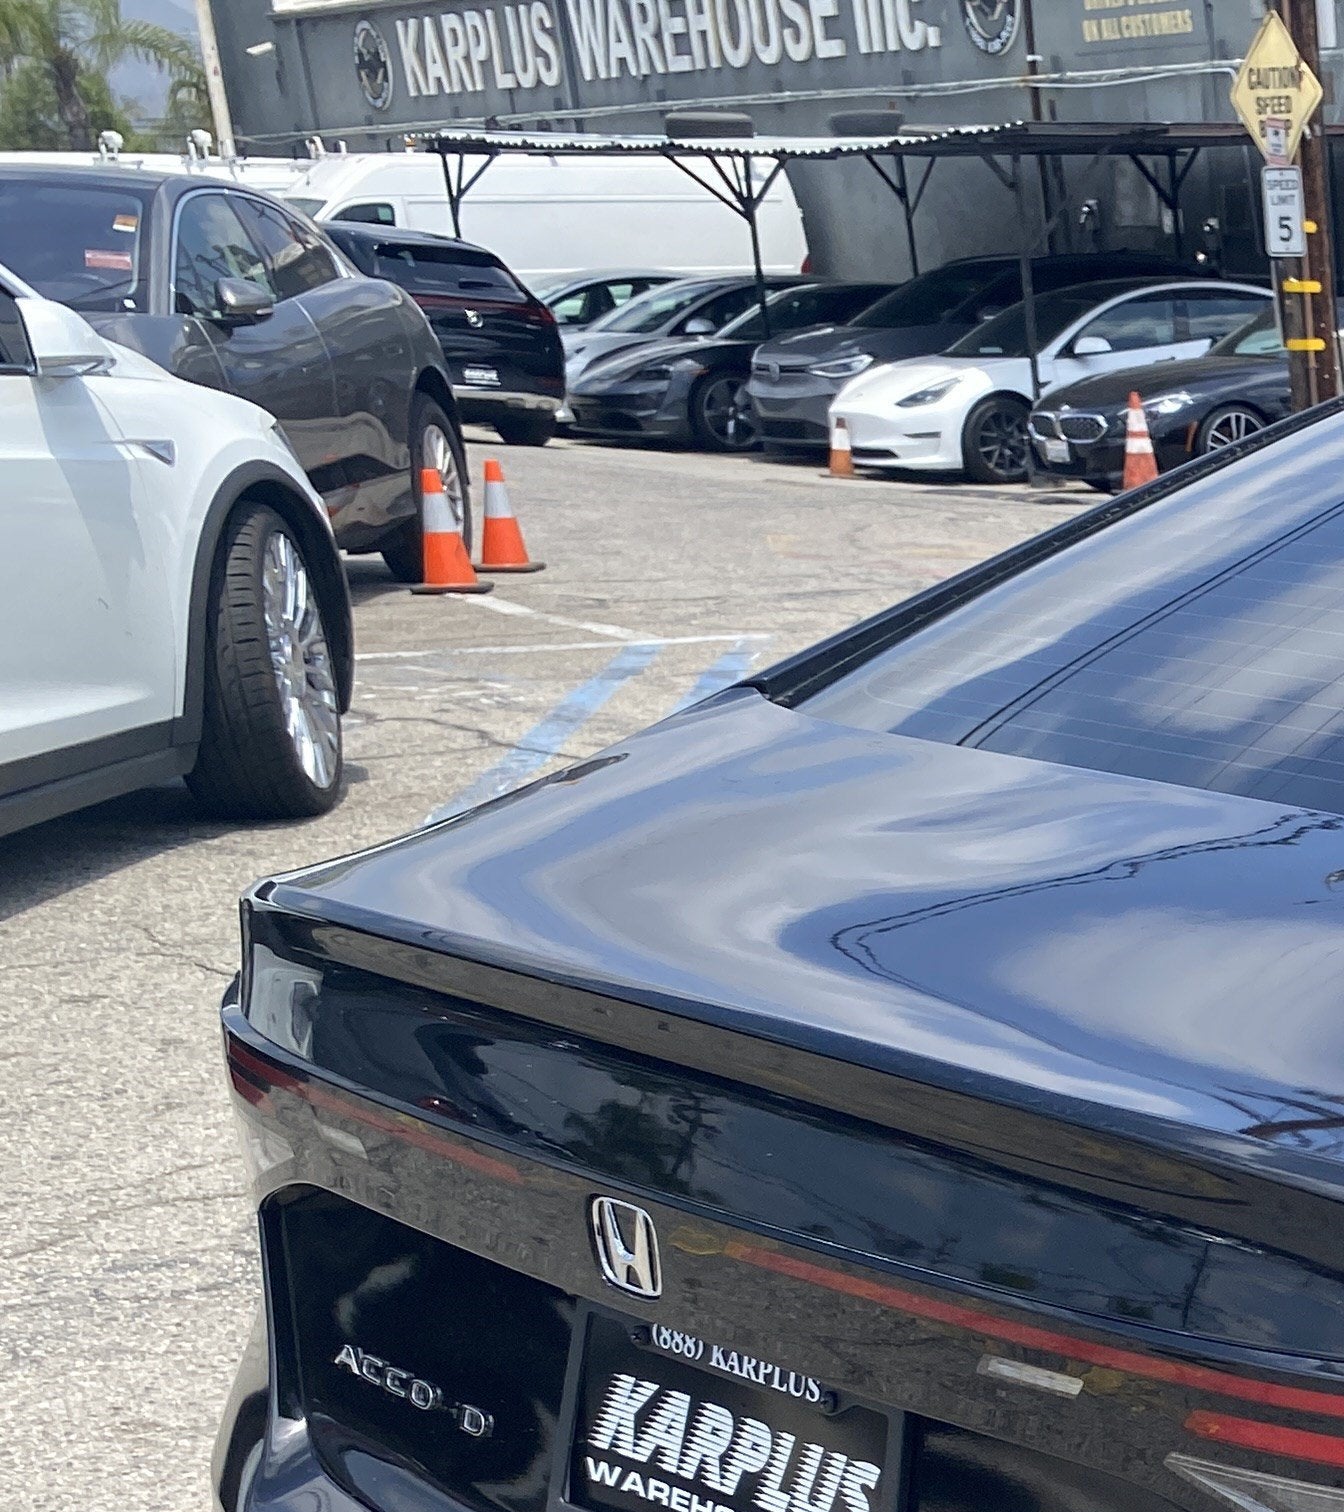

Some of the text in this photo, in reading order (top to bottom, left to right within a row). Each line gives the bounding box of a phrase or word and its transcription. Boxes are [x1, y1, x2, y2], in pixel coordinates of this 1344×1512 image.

[396, 1, 561, 97] KARPLUS
[567, 0, 846, 82] WAREHOUSE
[1279, 216, 1293, 242] 5
[334, 1344, 494, 1438] ACCOD
[709, 1345, 822, 1403] KARPLUS
